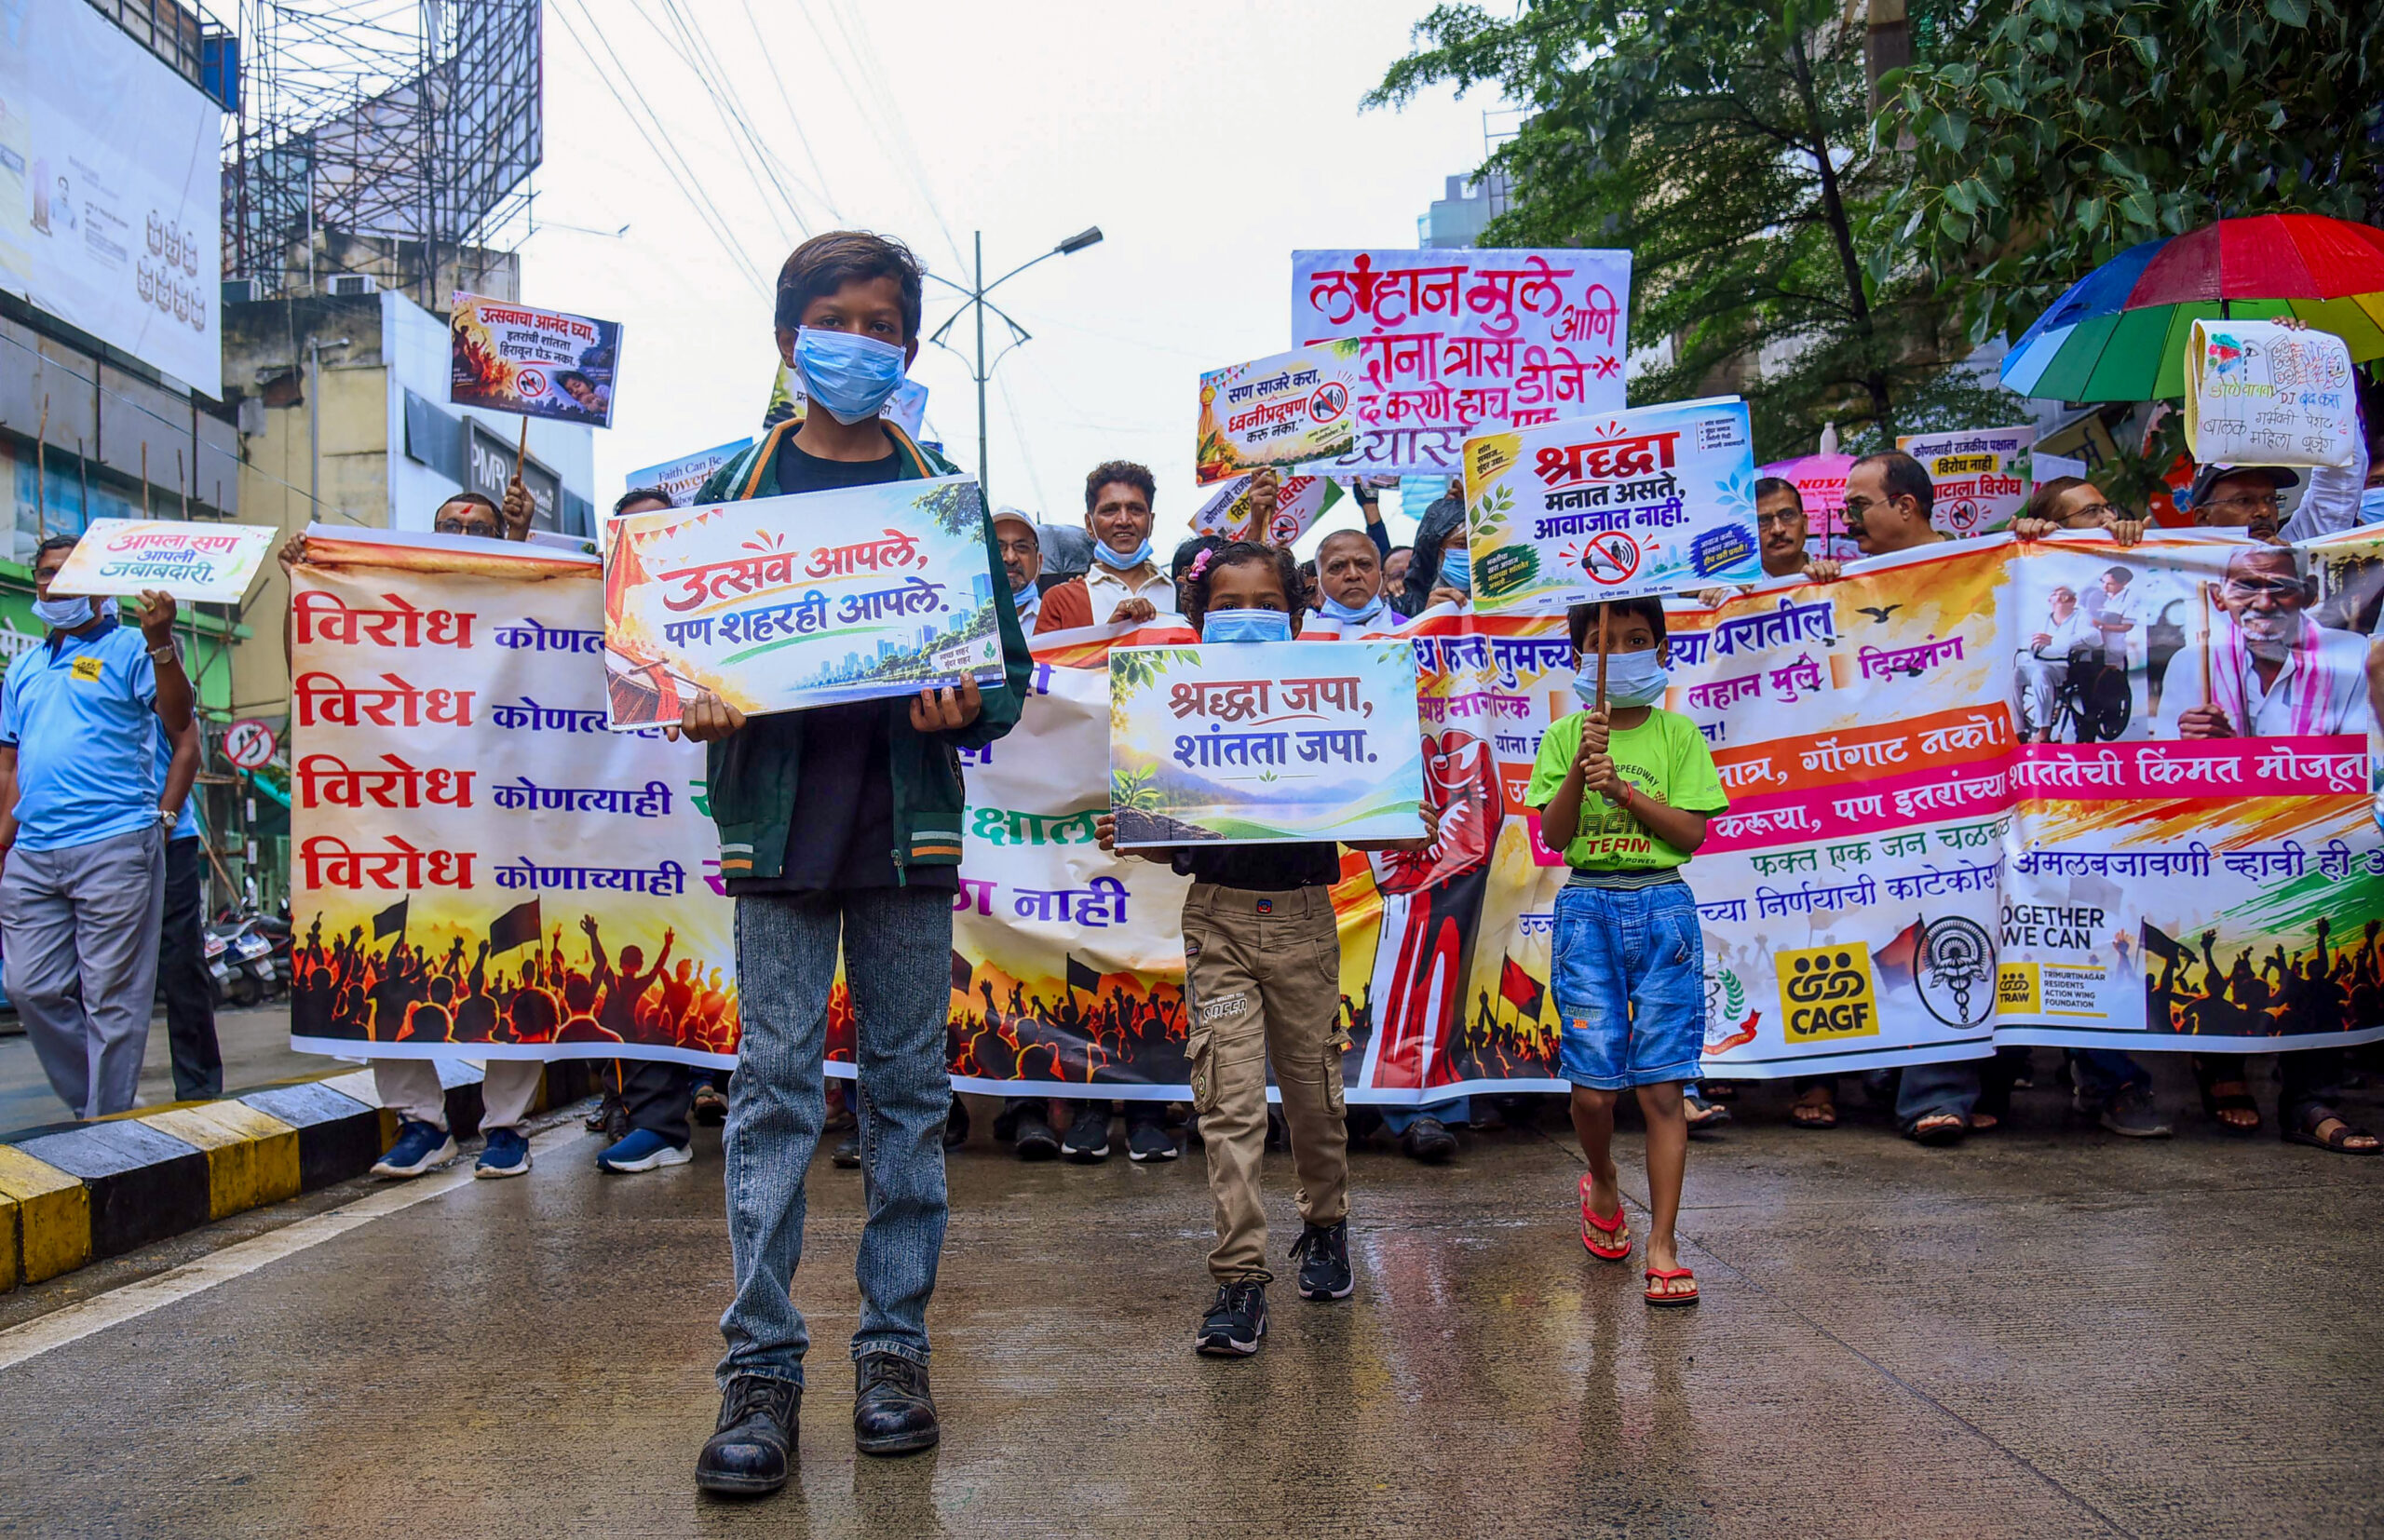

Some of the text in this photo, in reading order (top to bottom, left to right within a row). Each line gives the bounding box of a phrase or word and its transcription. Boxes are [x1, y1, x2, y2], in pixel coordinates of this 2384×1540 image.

[1466, 255, 1575, 338] मुले
[1551, 284, 1619, 346] आणि
[481, 307, 595, 345] उत्सवाचा आनंद घ्या,
[507, 330, 571, 351] इतरांची शांतता
[500, 342, 576, 367] हिरावून घेऊ नका.
[1228, 369, 1321, 404] सण साजरे करा,
[2319, 393, 2342, 410] करा
[1228, 397, 1308, 434] ध्वनीप्रदूषण
[1387, 381, 1455, 426] करणे
[1453, 387, 1510, 426] हाच
[2203, 419, 2247, 436] बालक
[2250, 429, 2292, 451] महिला
[1534, 432, 1680, 486] श्रद्धा
[1913, 438, 2018, 458] कोणत्याही राजकीय पक्षाला
[657, 467, 714, 494] Powerf
[658, 455, 722, 481] Faith Can Be
[1938, 455, 1992, 475] विरोध नाही
[1545, 470, 1686, 511] मनात असते,
[1979, 473, 2022, 496] विरोध
[1203, 490, 1235, 524] कोणत्याही
[1230, 497, 1250, 520] विरो
[1534, 497, 1689, 539] आवाजात नाही.
[107, 534, 240, 555] आपला सण
[137, 548, 197, 563] आपली
[100, 561, 214, 586] जबाबदारी.
[657, 529, 928, 611] उत्सव आपले,
[293, 591, 477, 649] विरोध
[663, 576, 949, 649] पण शहरही आपले.
[1492, 639, 1574, 689] तुमच्य
[1714, 599, 1833, 654] घरातील
[1448, 685, 1530, 720] नागरिक
[1688, 673, 1761, 709] लहान
[1770, 653, 1819, 703] मुले
[1859, 635, 1964, 682] दिव्यांग
[294, 671, 476, 727] विरोध
[1168, 677, 1374, 723] श्रद्धा जपा,
[1173, 723, 1378, 768] शांतता जपा.
[1495, 729, 1526, 753] यांना
[1799, 736, 1908, 772] गोंगाट
[1918, 714, 2007, 755] नको!
[297, 752, 477, 809] विरोध
[493, 777, 672, 817] कोणत्याही
[1615, 764, 1659, 787] SPEEDWAY
[1832, 793, 1886, 821] पण
[1892, 770, 2006, 818] इतरांच्या
[2135, 746, 2242, 786] किंमत
[2255, 746, 2367, 791] मोजून
[1587, 838, 1650, 855] TEAM
[1750, 848, 1817, 876] फक्त
[1826, 842, 1873, 871] एक
[1879, 831, 1926, 860] जन
[300, 835, 477, 890] विरोध
[494, 856, 686, 897] कोणाच्याही
[1013, 875, 1130, 927] नाही
[1755, 872, 1876, 920] निर्णयाची
[2012, 840, 2212, 879] अंमलबजावणी
[2222, 840, 2306, 882] व्हावी
[2317, 840, 2351, 881] ही
[2001, 905, 2105, 928] OGETHER
[2000, 926, 2091, 950] WE CAN
[2043, 971, 2106, 980] TRIMURTINAGAR
[2044, 980, 2084, 989] RESIDENTS
[1999, 993, 2029, 1003] TRAW
[2045, 998, 2094, 1008] FOUNDATION
[1790, 1003, 1868, 1035] CAGF
